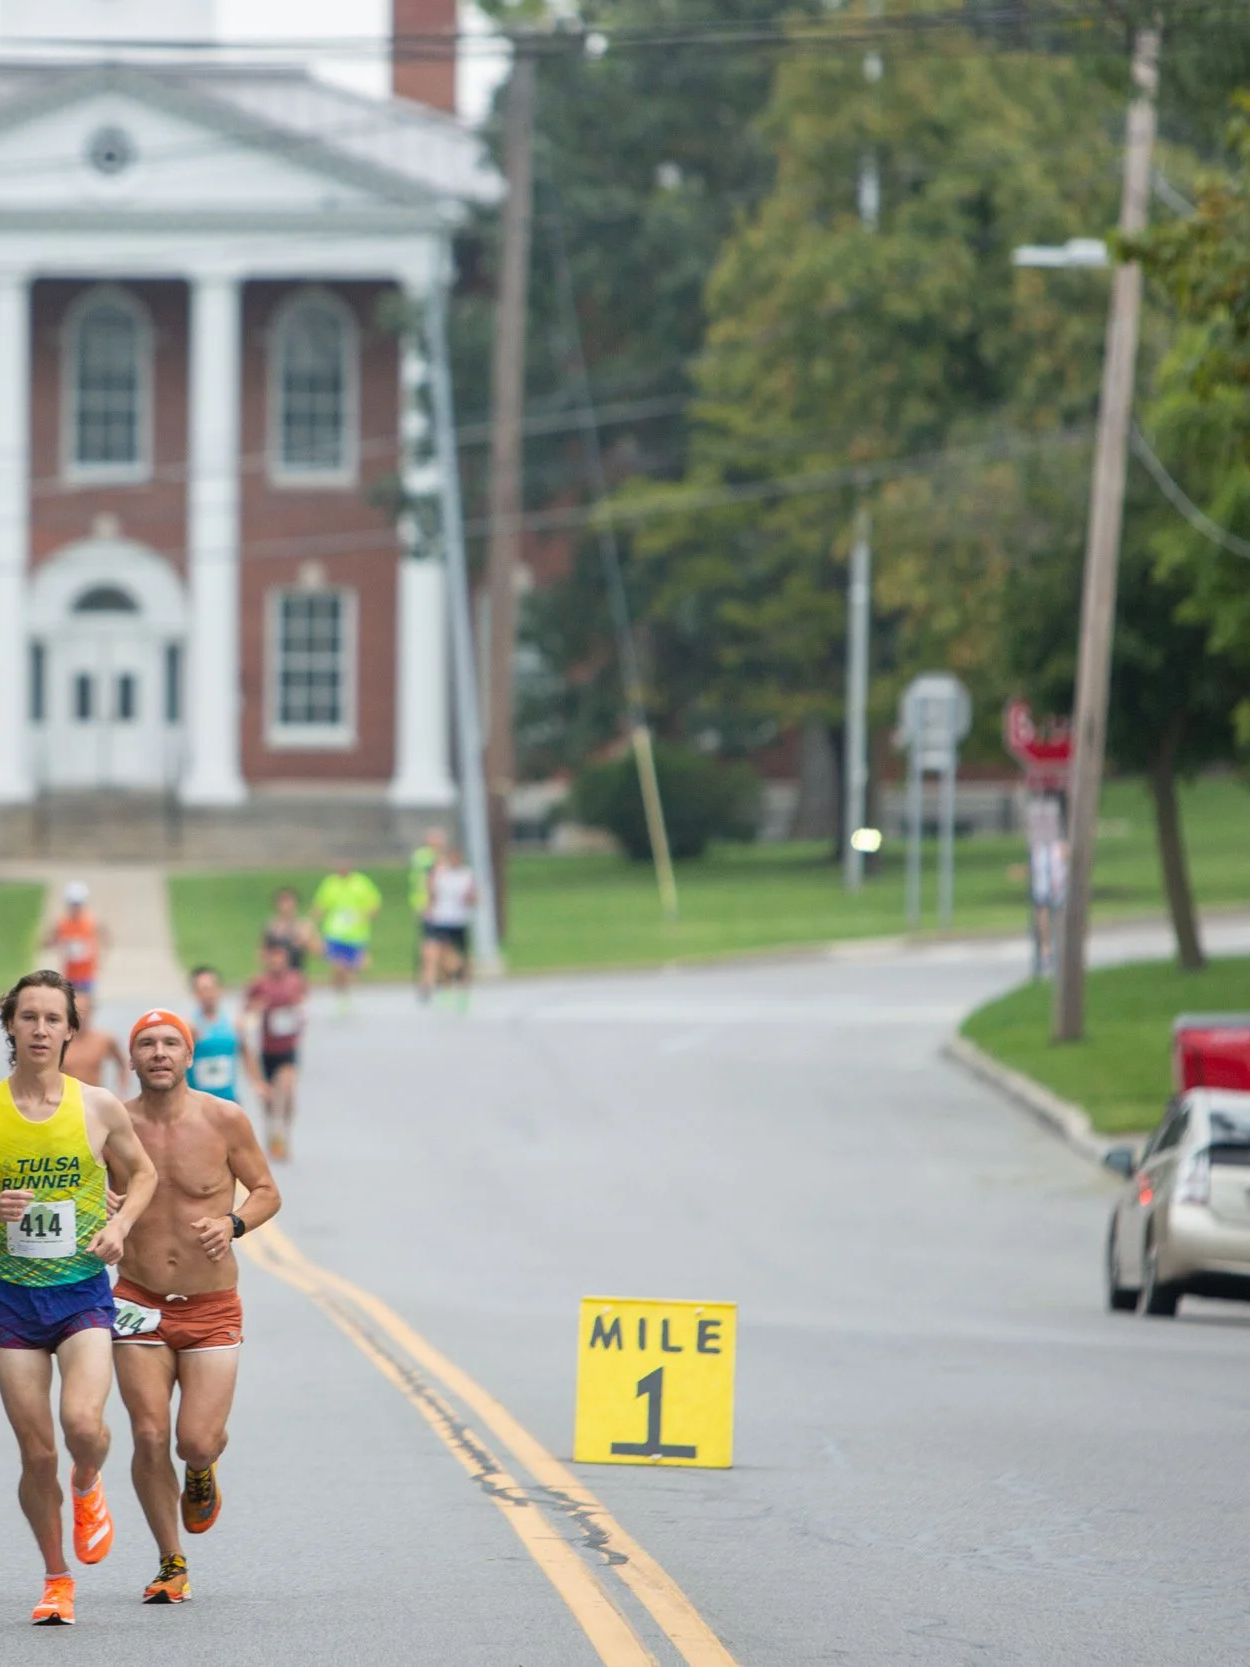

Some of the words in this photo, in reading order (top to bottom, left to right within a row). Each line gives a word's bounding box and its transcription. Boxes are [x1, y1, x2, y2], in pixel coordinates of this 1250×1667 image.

[17, 1156, 80, 1173] TULSA
[2, 1173, 81, 1191] RUNNER
[19, 1213, 62, 1237] 414
[589, 1314, 722, 1354] MILE
[636, 1366, 698, 1459] 1
